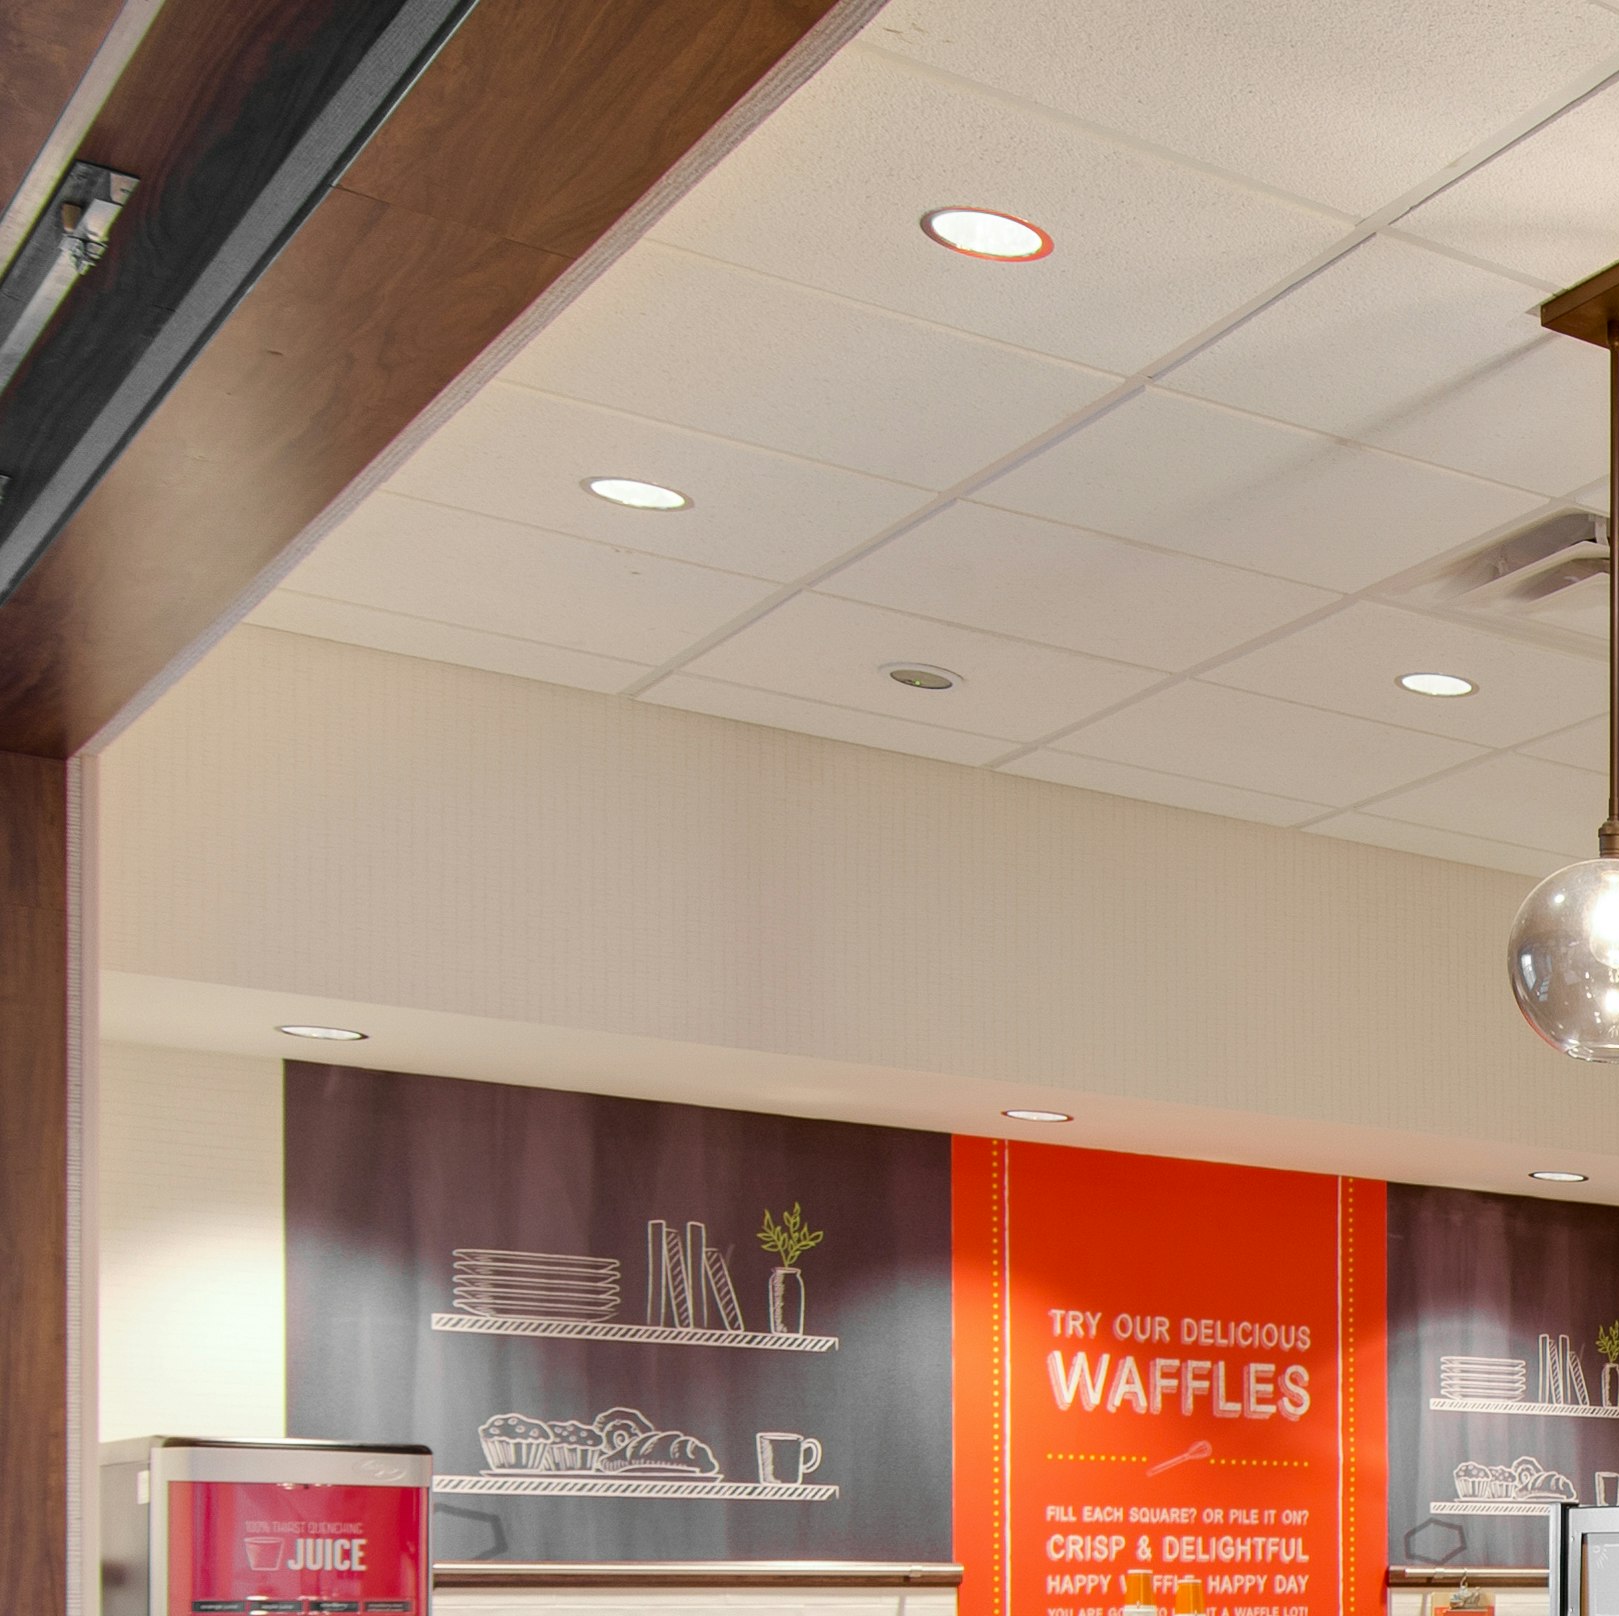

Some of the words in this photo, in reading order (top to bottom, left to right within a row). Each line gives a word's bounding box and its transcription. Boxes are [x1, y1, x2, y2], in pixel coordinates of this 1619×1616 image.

[1049, 1309, 1101, 1339] TRY
[1113, 1313, 1170, 1343] OUR
[1181, 1318, 1310, 1351] DELICIOUS
[1047, 1350, 1311, 1421] WAFFLES
[1046, 1506, 1077, 1522] FILL
[1083, 1506, 1123, 1522] EACH
[1129, 1507, 1197, 1524] SQUARE?
[1202, 1508, 1224, 1524] OR
[1229, 1509, 1259, 1525] PILE
[1264, 1509, 1276, 1525] IT
[1281, 1509, 1309, 1526] ON?
[287, 1538, 367, 1571] JUICE
[1046, 1533, 1126, 1562] CRISP
[1136, 1535, 1152, 1561] &
[1162, 1535, 1310, 1563] DELIGHTFUL
[1046, 1575, 1111, 1595] HAPPY
[1207, 1575, 1268, 1595] HAPPY
[1274, 1575, 1309, 1594] DAY
